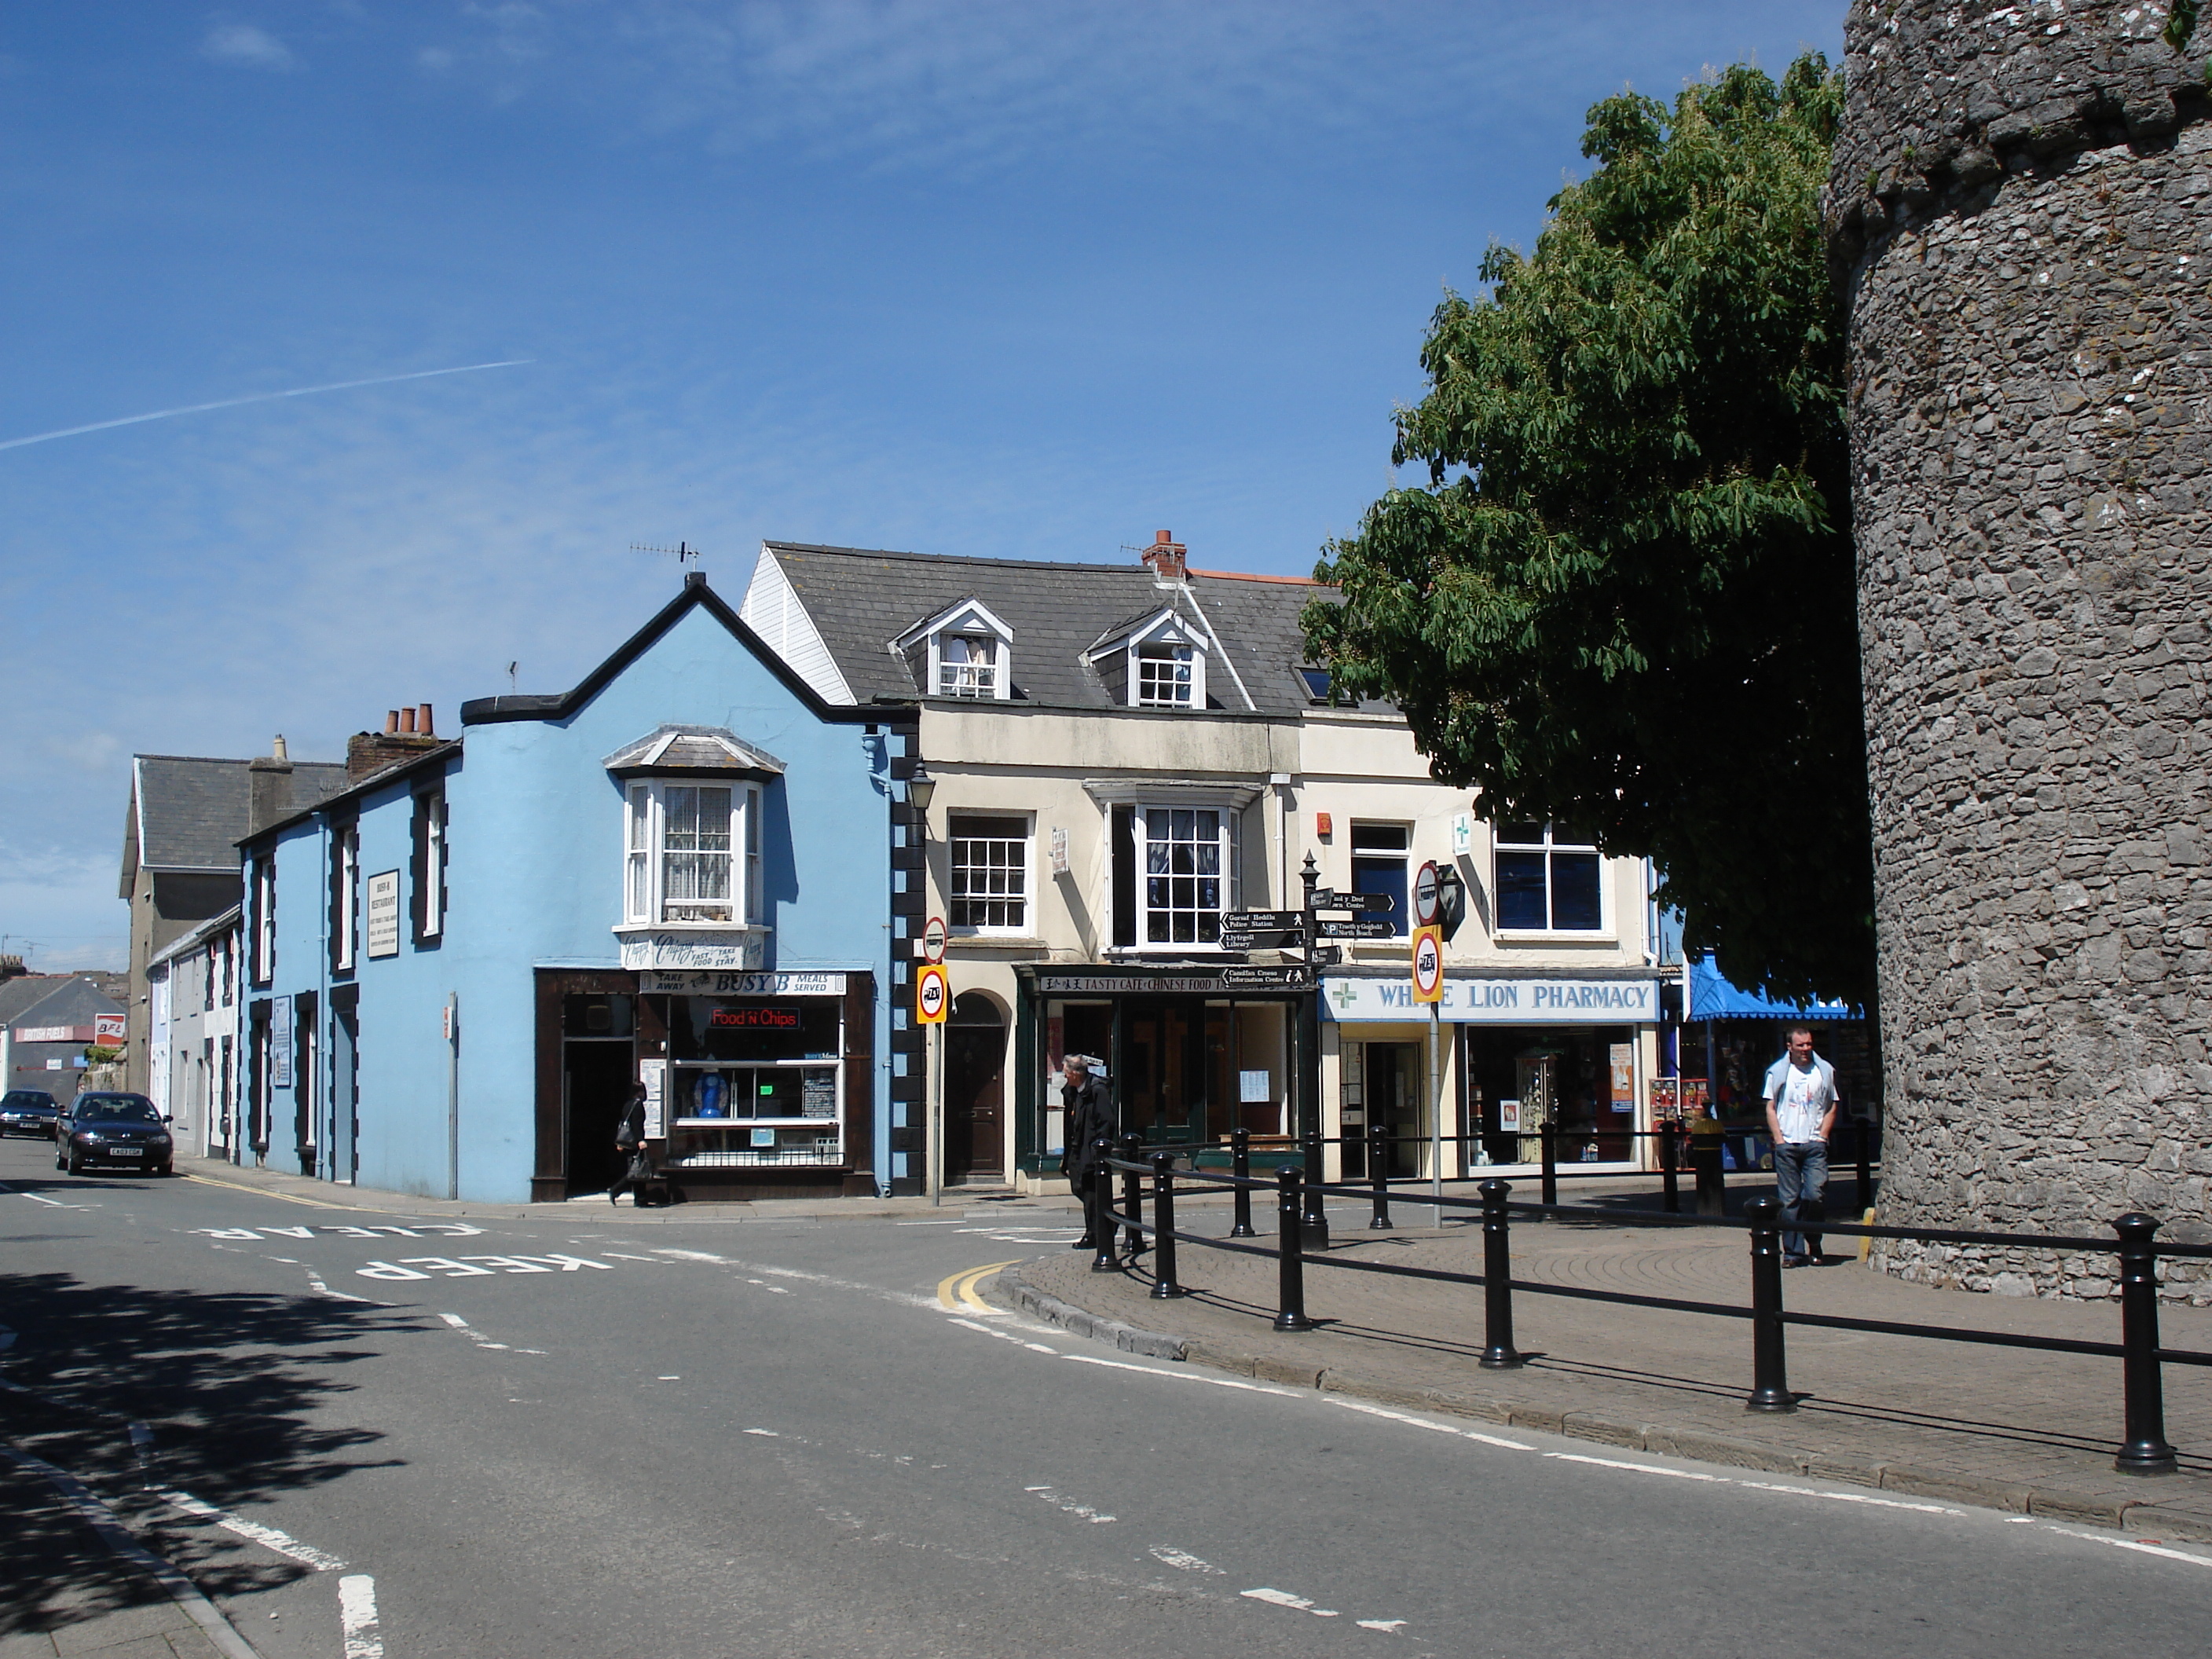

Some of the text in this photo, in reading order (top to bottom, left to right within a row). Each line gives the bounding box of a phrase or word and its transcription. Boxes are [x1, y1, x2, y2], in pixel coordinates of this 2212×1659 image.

[691, 952, 709, 961] FAST
[694, 958, 712, 967] FOOD
[716, 974, 790, 992] BUSY B
[797, 974, 829, 983] MEALS
[1084, 979, 1118, 991] TASTY
[1120, 979, 1143, 991] CAFE
[1148, 979, 1185, 991] CHINESE
[1188, 979, 1211, 991] FOOD
[657, 982, 685, 991] AWAY
[1377, 985, 1650, 1008] WHE LION PHARMACY
[712, 1009, 745, 1025] Food
[760, 1009, 797, 1028] Chips
[24, 1026, 65, 1041] BRITISH FUELS
[98, 1023, 121, 1033] BFL
[197, 1223, 485, 1241] CLEAR
[355, 1253, 615, 1280] KEEP
